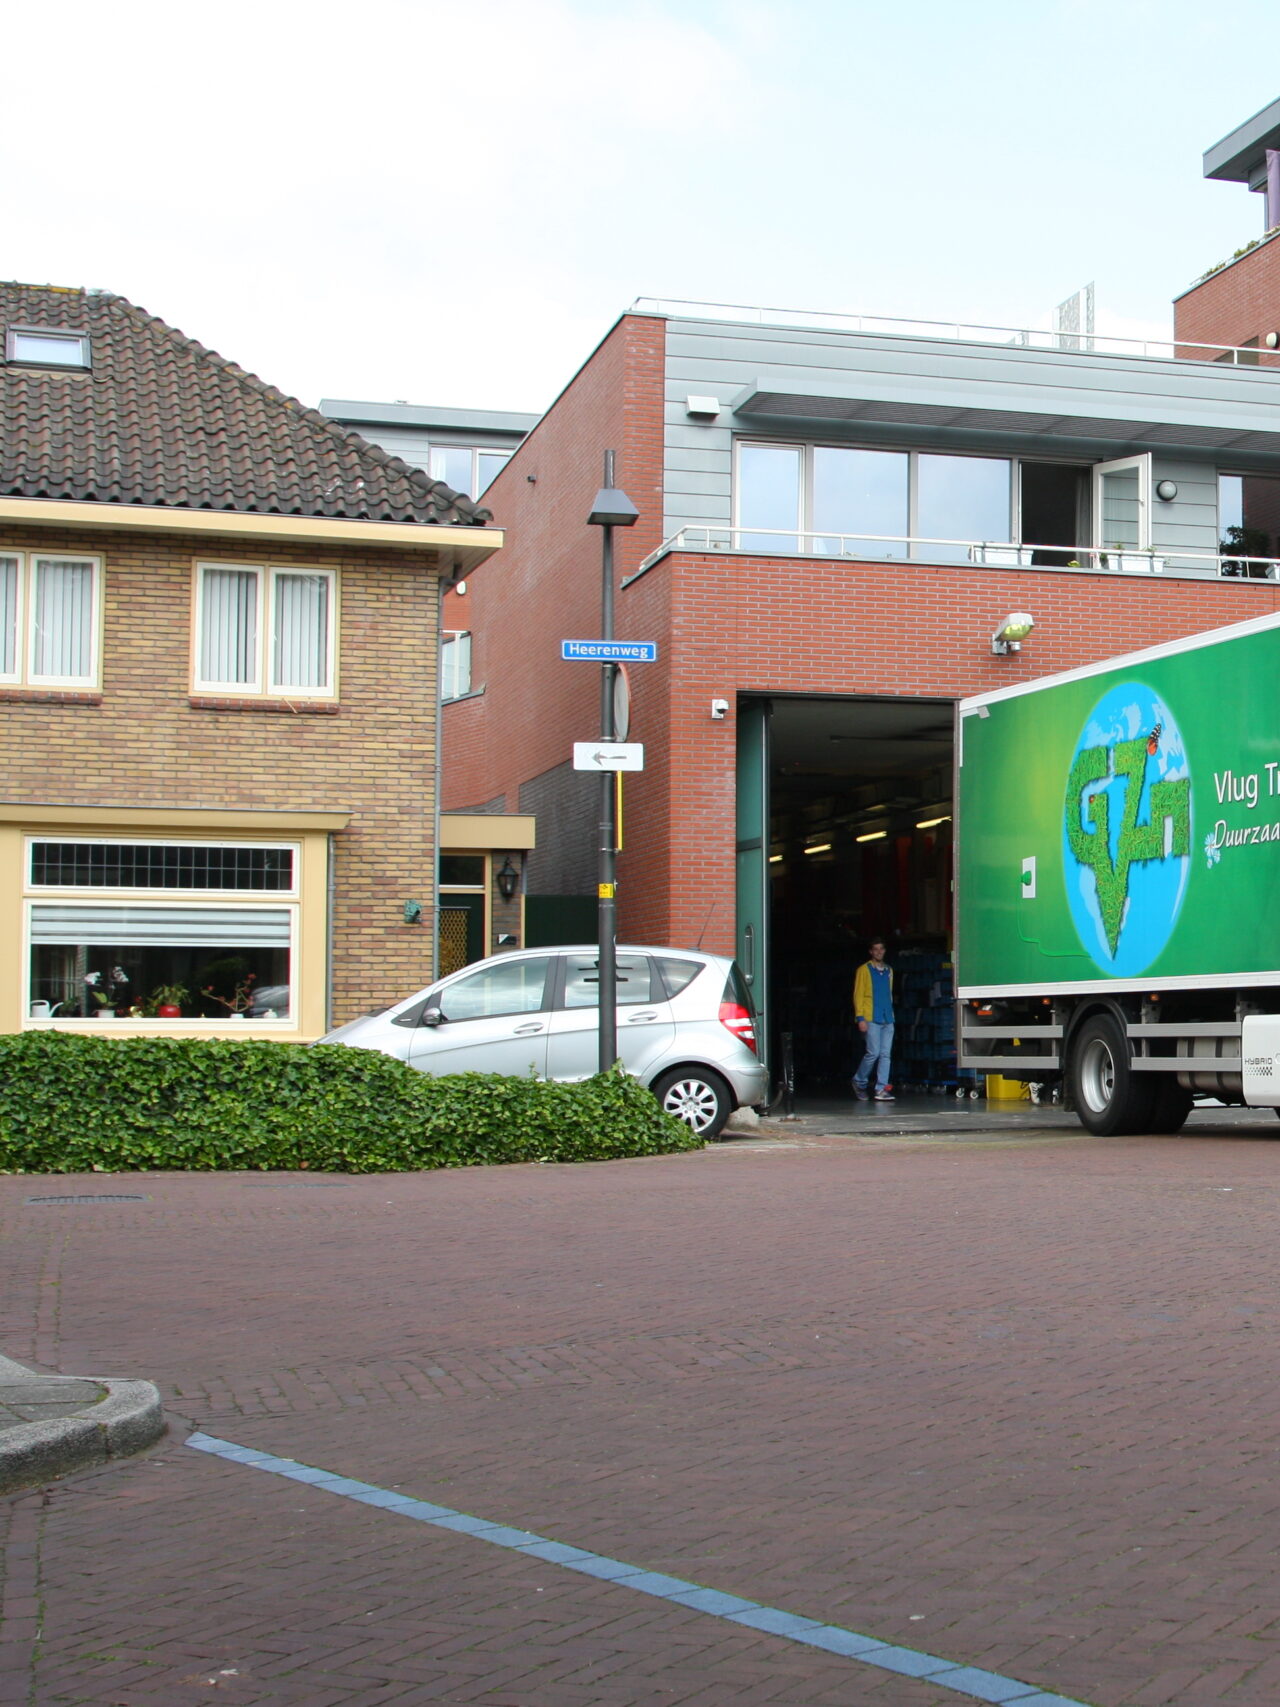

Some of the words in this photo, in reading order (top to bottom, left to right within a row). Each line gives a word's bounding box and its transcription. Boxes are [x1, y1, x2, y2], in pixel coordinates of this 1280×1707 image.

[569, 643, 648, 659] Heerenweg
[1213, 770, 1258, 808] Vlug
[1245, 1057, 1272, 1065] HYBRID
